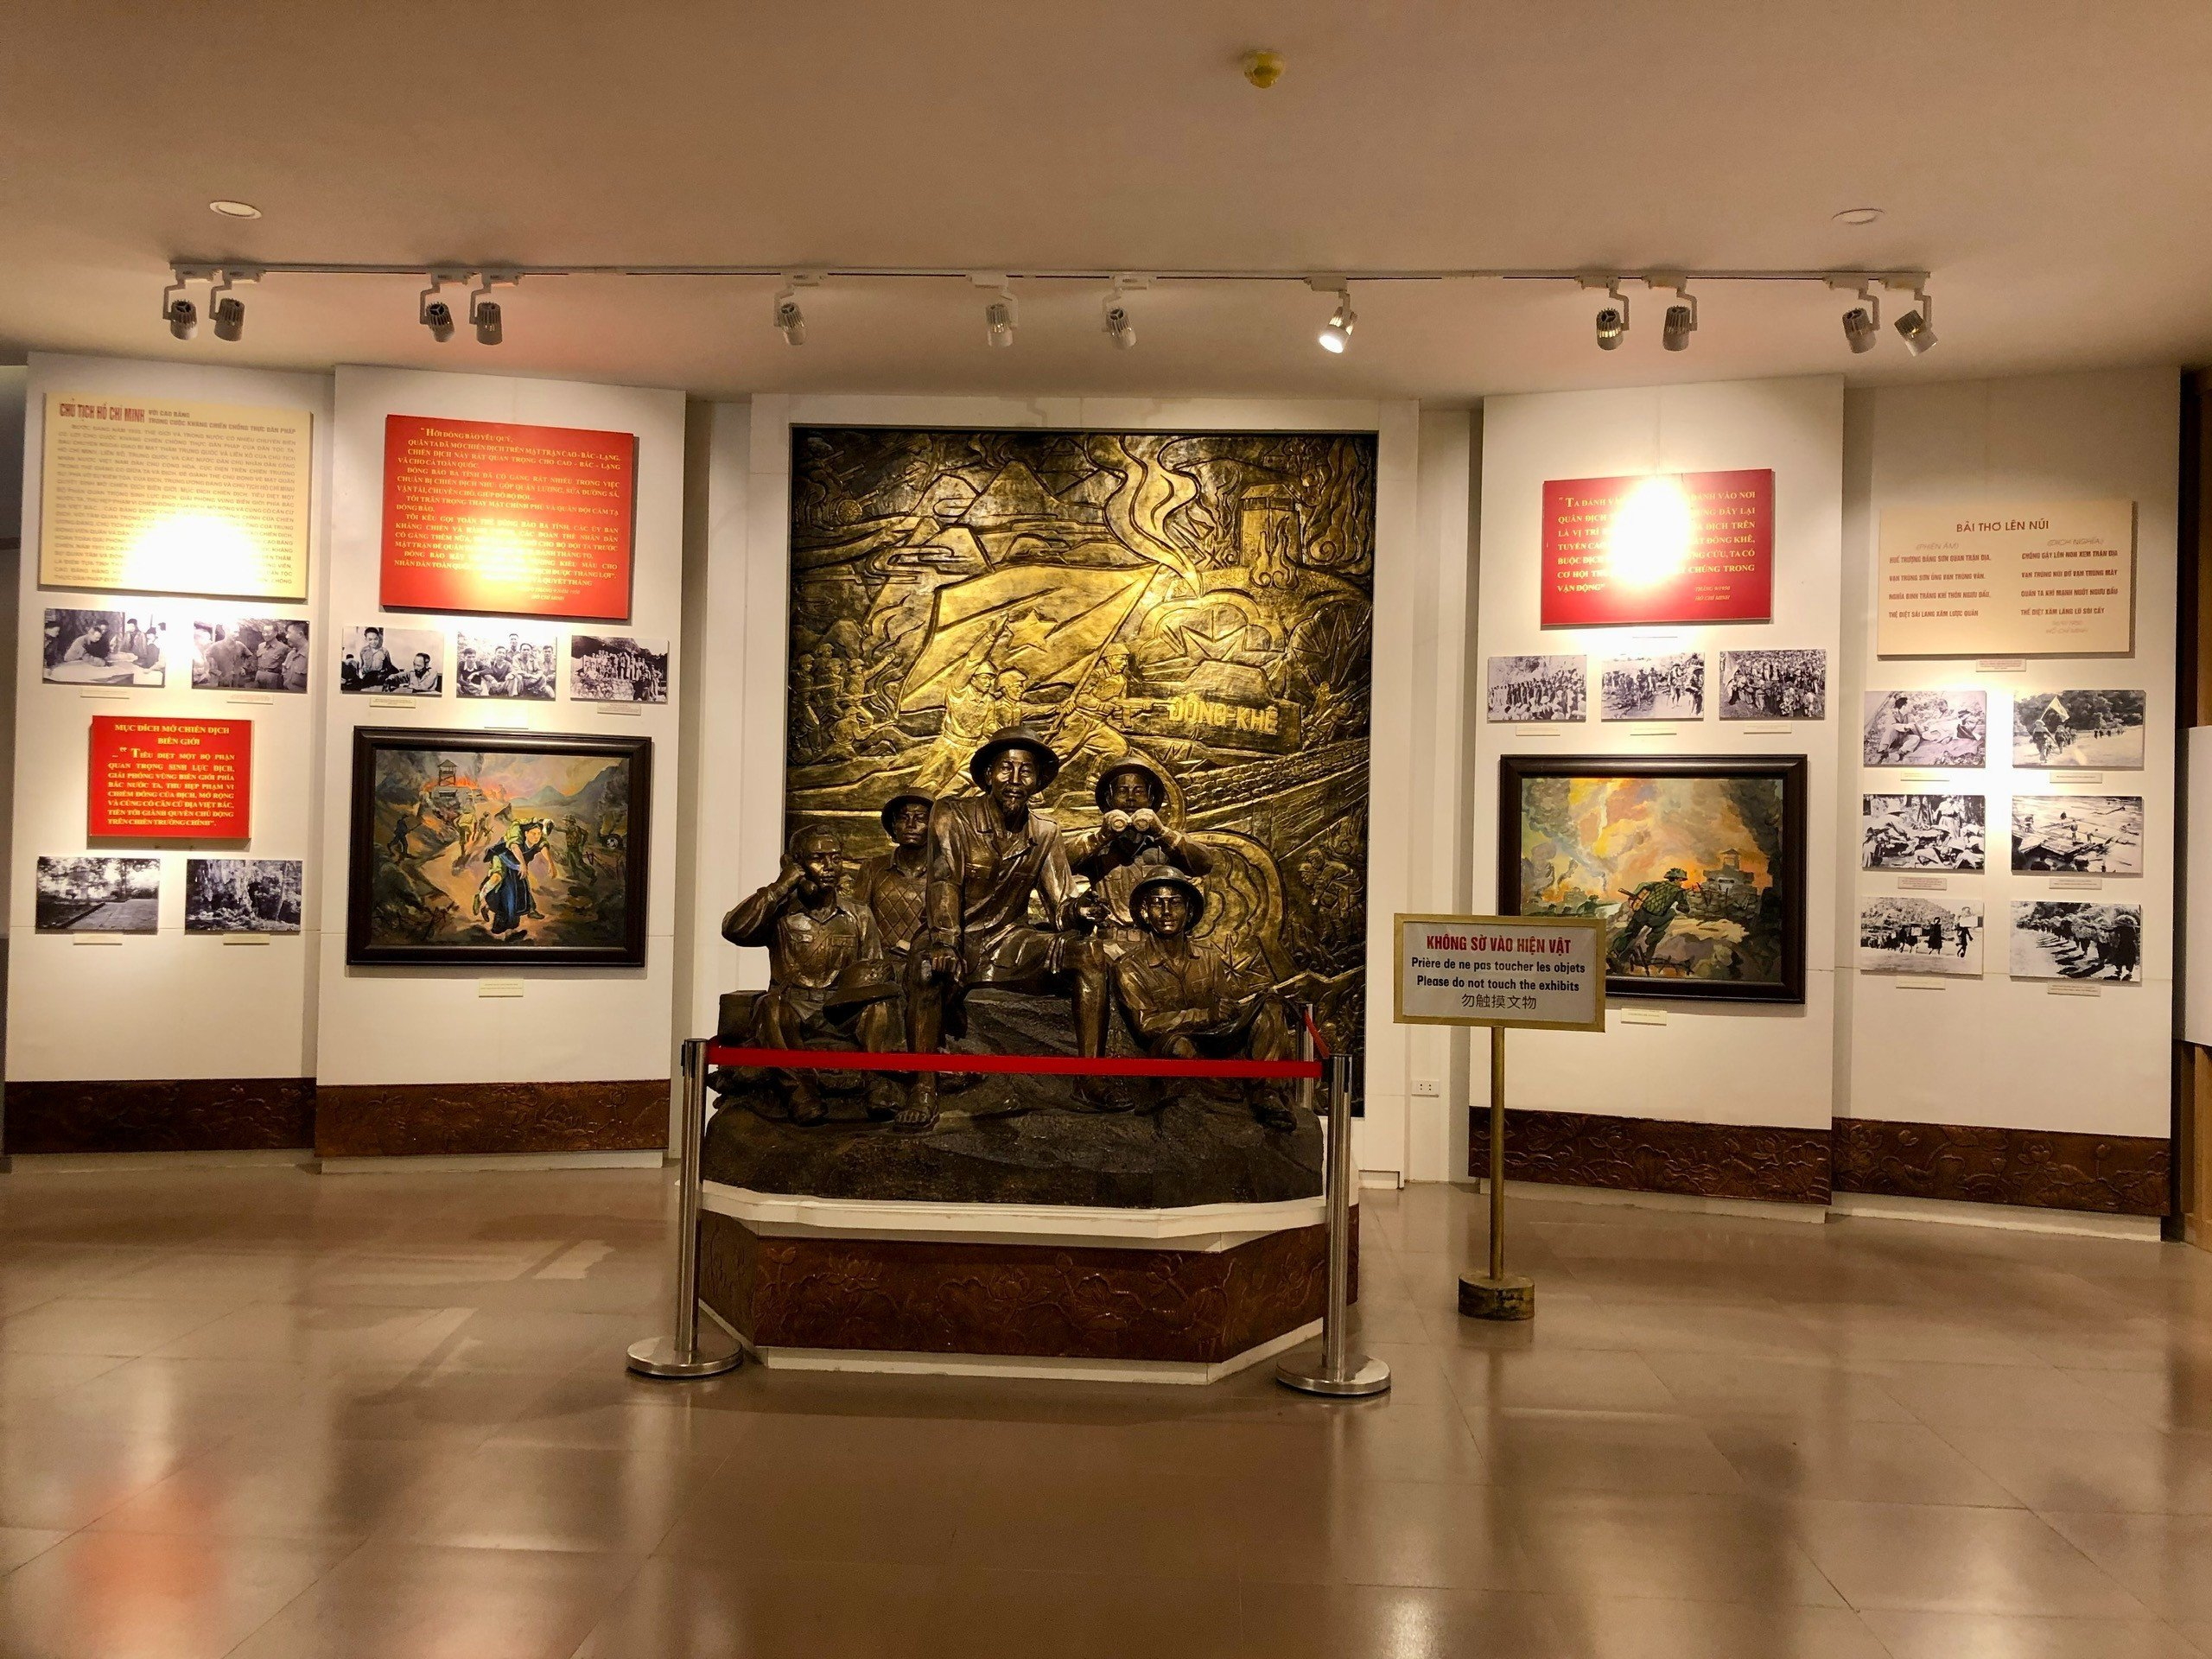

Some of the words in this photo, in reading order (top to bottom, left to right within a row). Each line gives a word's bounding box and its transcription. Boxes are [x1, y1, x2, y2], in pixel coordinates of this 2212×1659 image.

[124, 408, 144, 423] MINH
[408, 438, 429, 447] QUÂN
[1719, 491, 1737, 499] VÀO
[1558, 514, 1582, 525] QUÂN
[1740, 507, 1755, 516] LẠI
[1558, 528, 1569, 537] LÀ
[1585, 527, 1599, 536] TRÍ
[1732, 520, 1755, 529] TRÊN
[1956, 522, 1974, 532] BÀI
[1979, 521, 2001, 532] THƠ
[2005, 519, 2025, 531] LÊN
[2029, 518, 2050, 530] NÚI
[1558, 542, 1586, 551] TUYẾN
[1557, 556, 1580, 566] BUỘC
[1742, 549, 1755, 557] CÓ
[1557, 570, 1571, 579] CƠ
[1690, 564, 1720, 573] CHÚNG
[1557, 584, 1575, 593] VẬN
[162, 724, 177, 733] MỞ
[178, 724, 206, 734] CHIẾN
[207, 727, 230, 736] DỊCH
[180, 737, 200, 746] GIỚI
[1427, 933, 1466, 950] KHÔNG
[1471, 934, 1487, 951] SỜ
[1491, 934, 1512, 952] VÀO
[1517, 936, 1545, 955] HIỆN
[1549, 936, 1571, 956] VẬT
[1412, 957, 1440, 969] Prière
[1444, 958, 1455, 969] de
[1459, 961, 1470, 969] ne
[1474, 962, 1491, 975] pas
[1495, 961, 1533, 971] toucher
[1537, 962, 1550, 972] les
[1554, 963, 1586, 975] objets
[1417, 976, 1449, 987] Please
[1452, 976, 1464, 988] do
[1468, 979, 1484, 988] not
[1488, 979, 1516, 989] touch
[1520, 980, 1535, 990] the
[1539, 980, 1580, 992] exhibits
[1461, 994, 1536, 1009] 勿触摸文物
